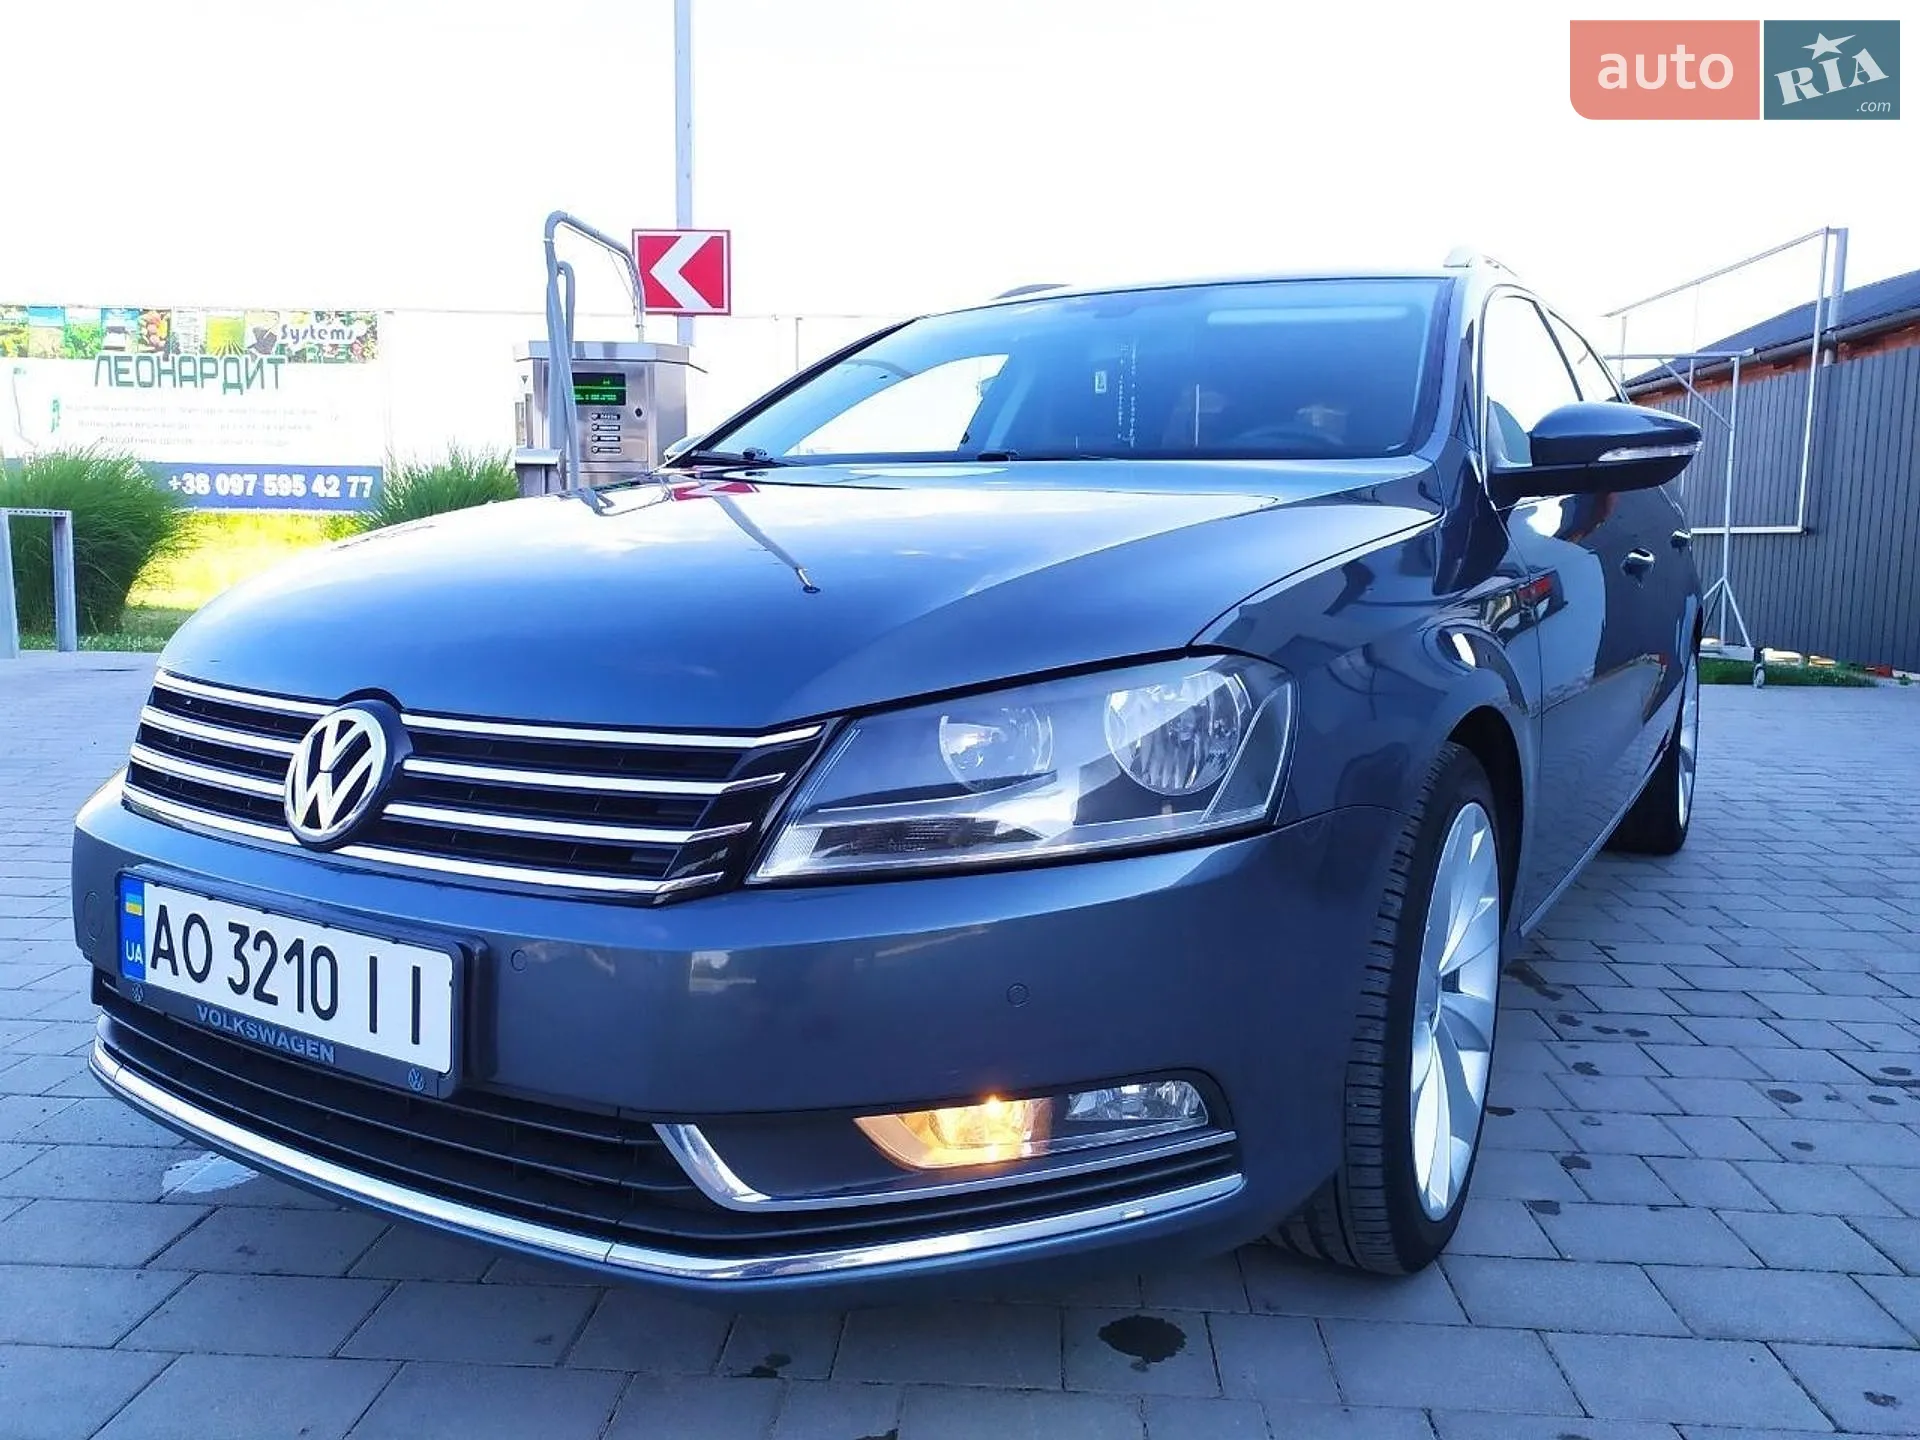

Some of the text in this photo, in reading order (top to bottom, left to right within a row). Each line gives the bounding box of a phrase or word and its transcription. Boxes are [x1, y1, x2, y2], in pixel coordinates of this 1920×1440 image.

[94, 355, 286, 395] ЛЕОНАРДИТ
[167, 473, 210, 495] +38
[214, 474, 258, 496] 097
[311, 475, 341, 498] 42
[347, 476, 374, 499] 77
[125, 940, 143, 965] UA
[150, 904, 213, 983] AO
[227, 922, 339, 1021] 3210
[196, 1003, 336, 1065] VOLKSWAGEN
